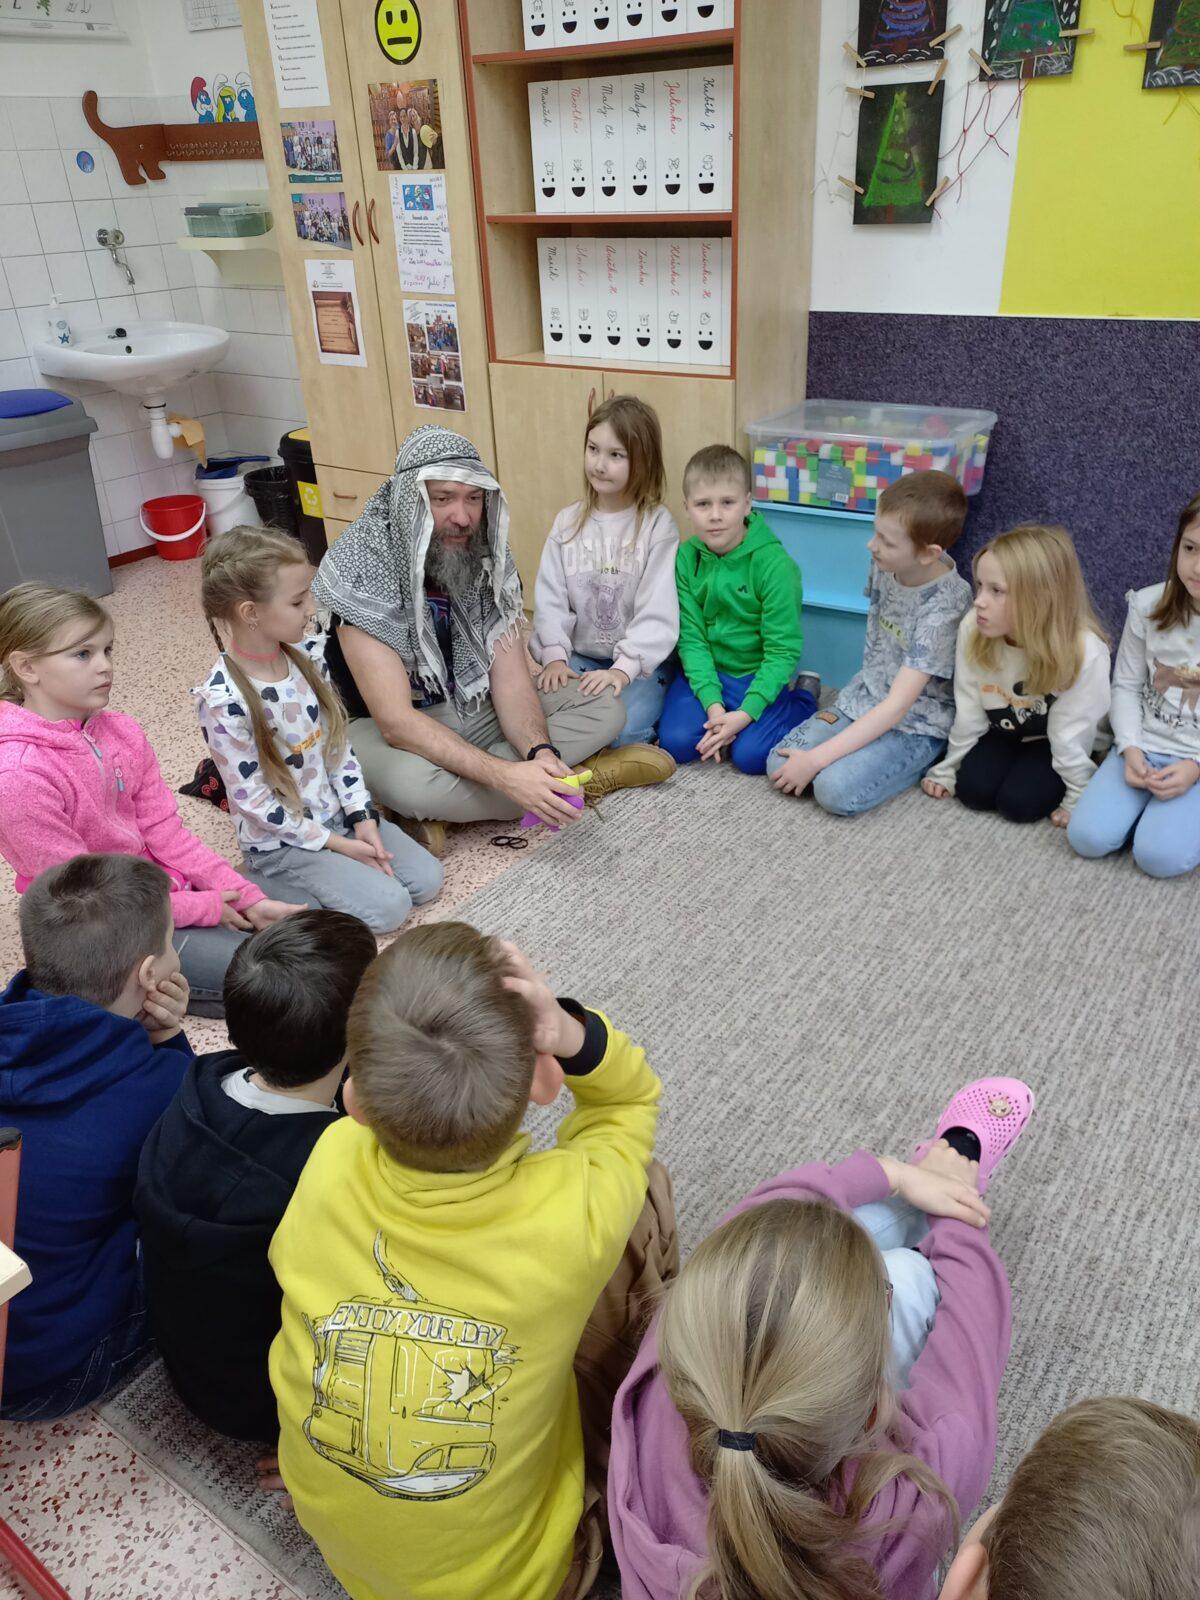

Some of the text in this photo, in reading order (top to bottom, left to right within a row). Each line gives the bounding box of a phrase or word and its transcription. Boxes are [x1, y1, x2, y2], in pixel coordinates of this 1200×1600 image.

[663, 80, 681, 135] Julinka
[331, 1305, 504, 1347] ENJOY YOUR DAY
